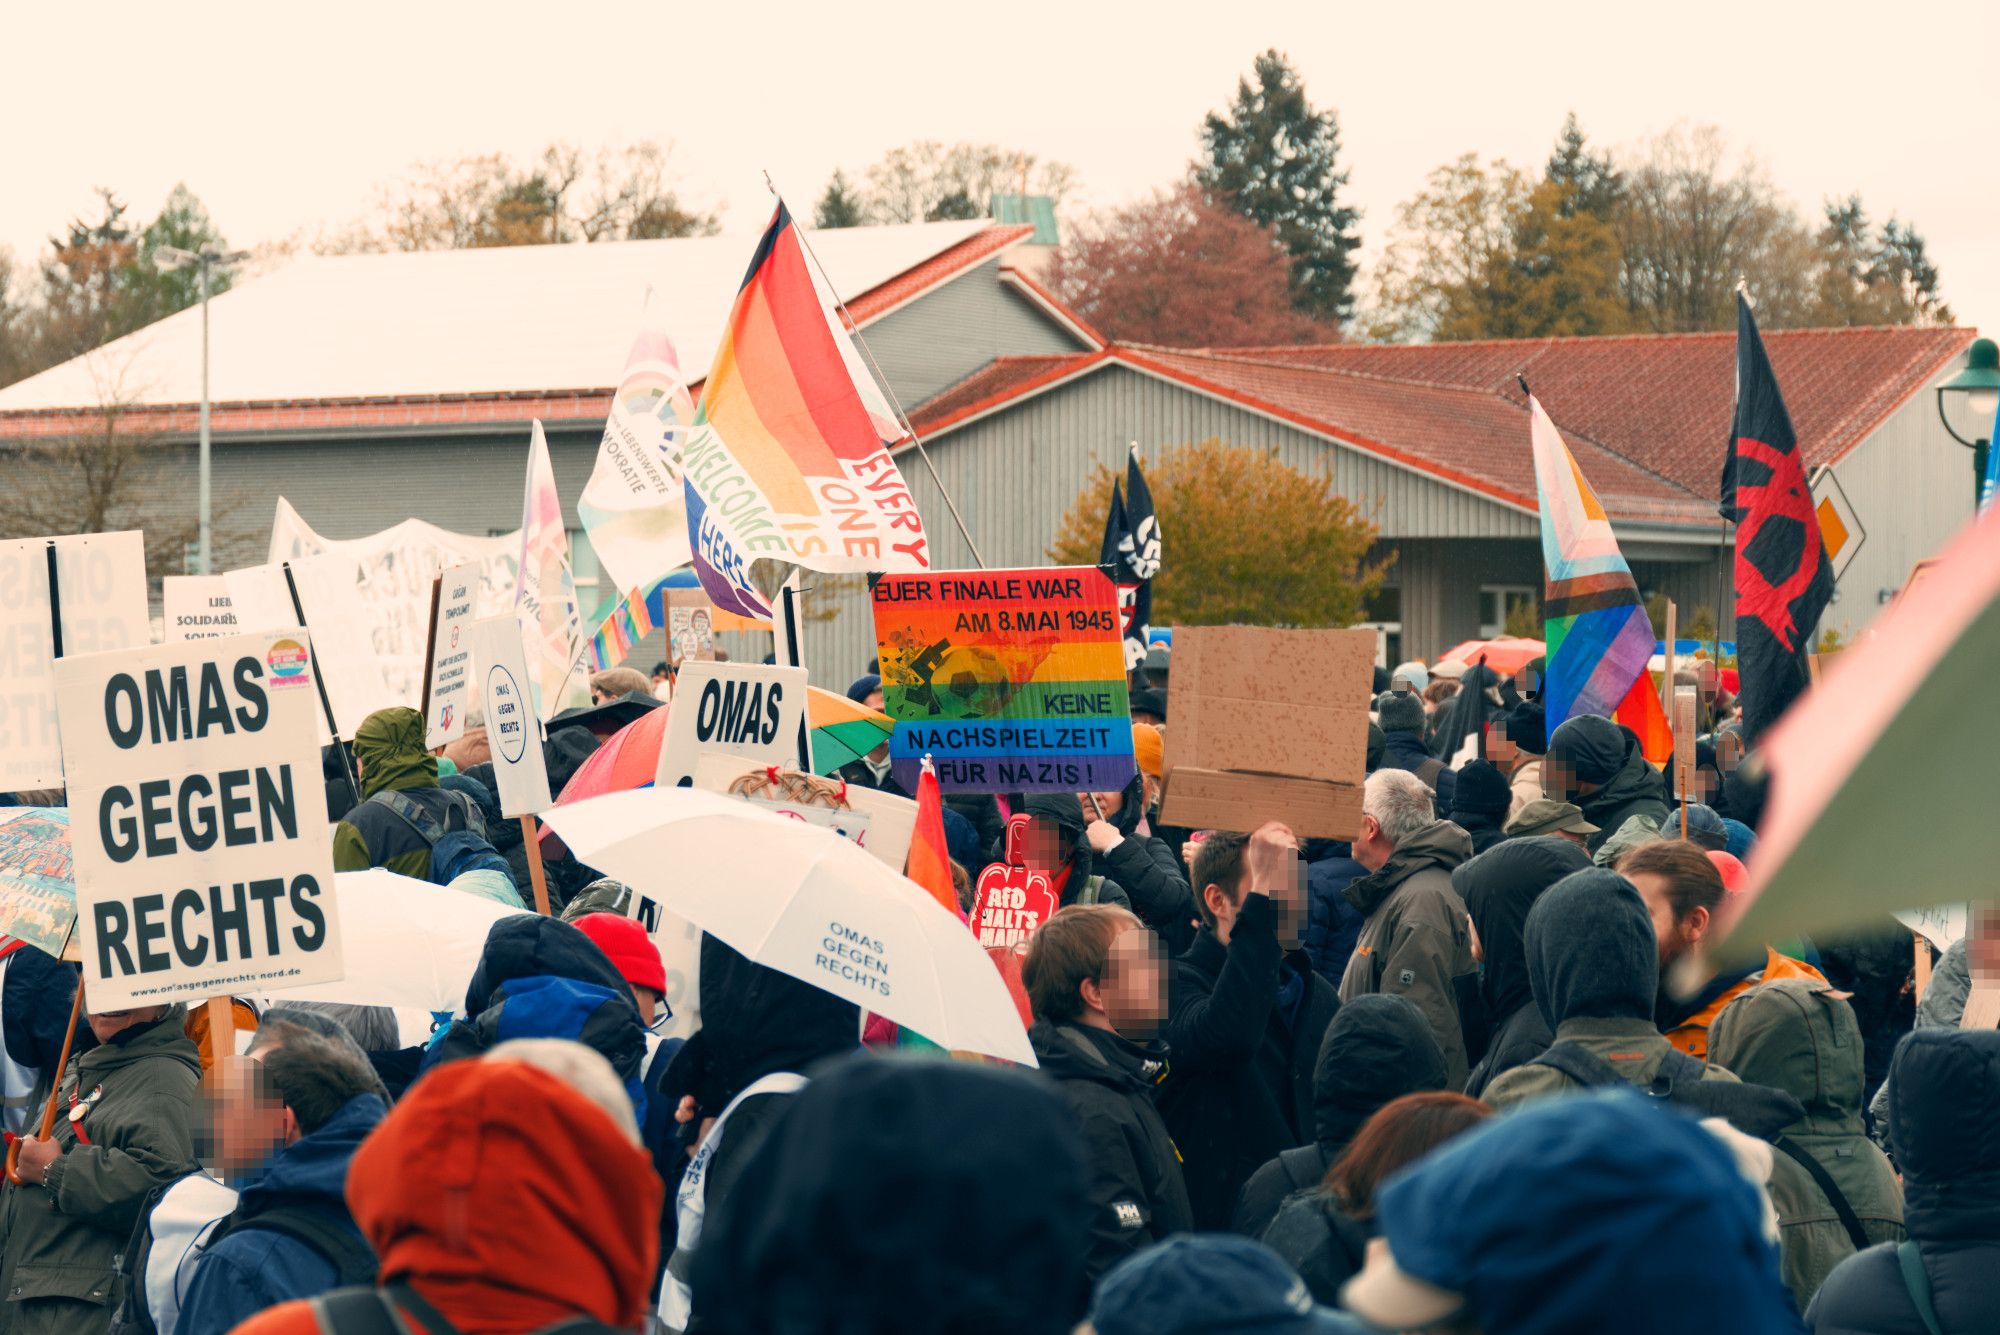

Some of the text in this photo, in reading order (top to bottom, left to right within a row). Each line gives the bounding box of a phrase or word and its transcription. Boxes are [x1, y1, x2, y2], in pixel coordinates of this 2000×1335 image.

[602, 430, 647, 495] MOKRATIE
[684, 430, 787, 552] WELCOME
[821, 482, 880, 561] ONE
[854, 454, 930, 568] EVERY
[781, 522, 828, 558] IS
[874, 578, 1082, 602] EUER FINALE WAR
[955, 612, 991, 632] AM
[1066, 610, 1114, 631] 1945
[104, 656, 269, 750] OMAS
[495, 684, 510, 697] OMAS
[1044, 693, 1112, 715] KEINE
[498, 703, 516, 715] GEGEN
[696, 679, 782, 745] OMAS
[500, 720, 520, 735] RECHTS
[908, 728, 1111, 750] NACHSPIELZEIT
[940, 760, 985, 784] FÜR
[99, 763, 299, 864] GEGEN
[986, 886, 1027, 910] AfD
[93, 873, 328, 979] RECHTS
[980, 907, 1039, 931] HALT'S
[830, 921, 885, 955] OMAS
[815, 952, 891, 997] RECHTS
[822, 938, 890, 976] GEGEN
